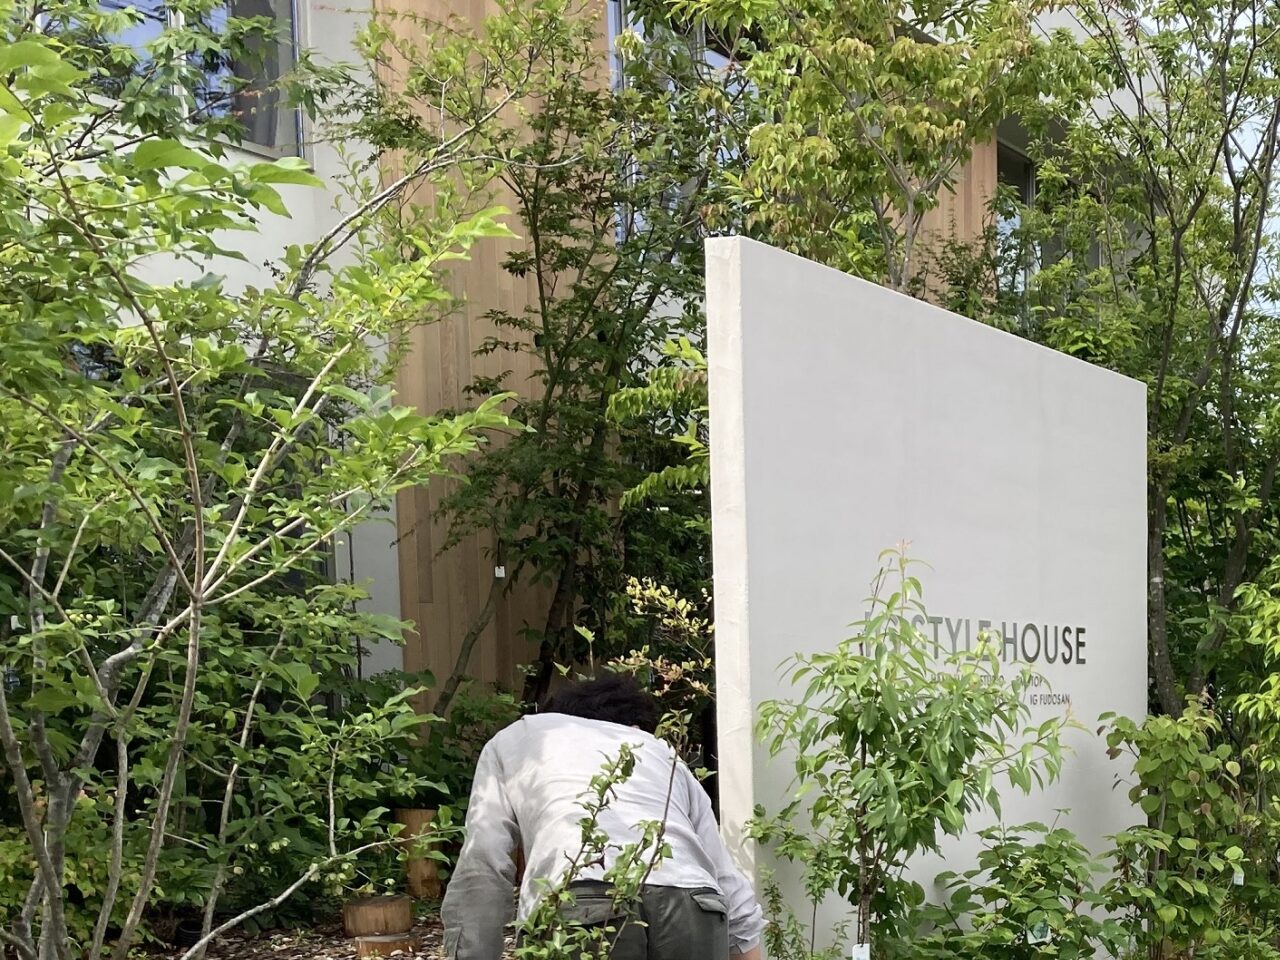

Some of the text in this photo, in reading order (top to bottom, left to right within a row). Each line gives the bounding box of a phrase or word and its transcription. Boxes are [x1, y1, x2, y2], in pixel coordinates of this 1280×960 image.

[1002, 621, 1087, 665] HOUSE
[1029, 693, 1071, 706] IG FUDOSAN
